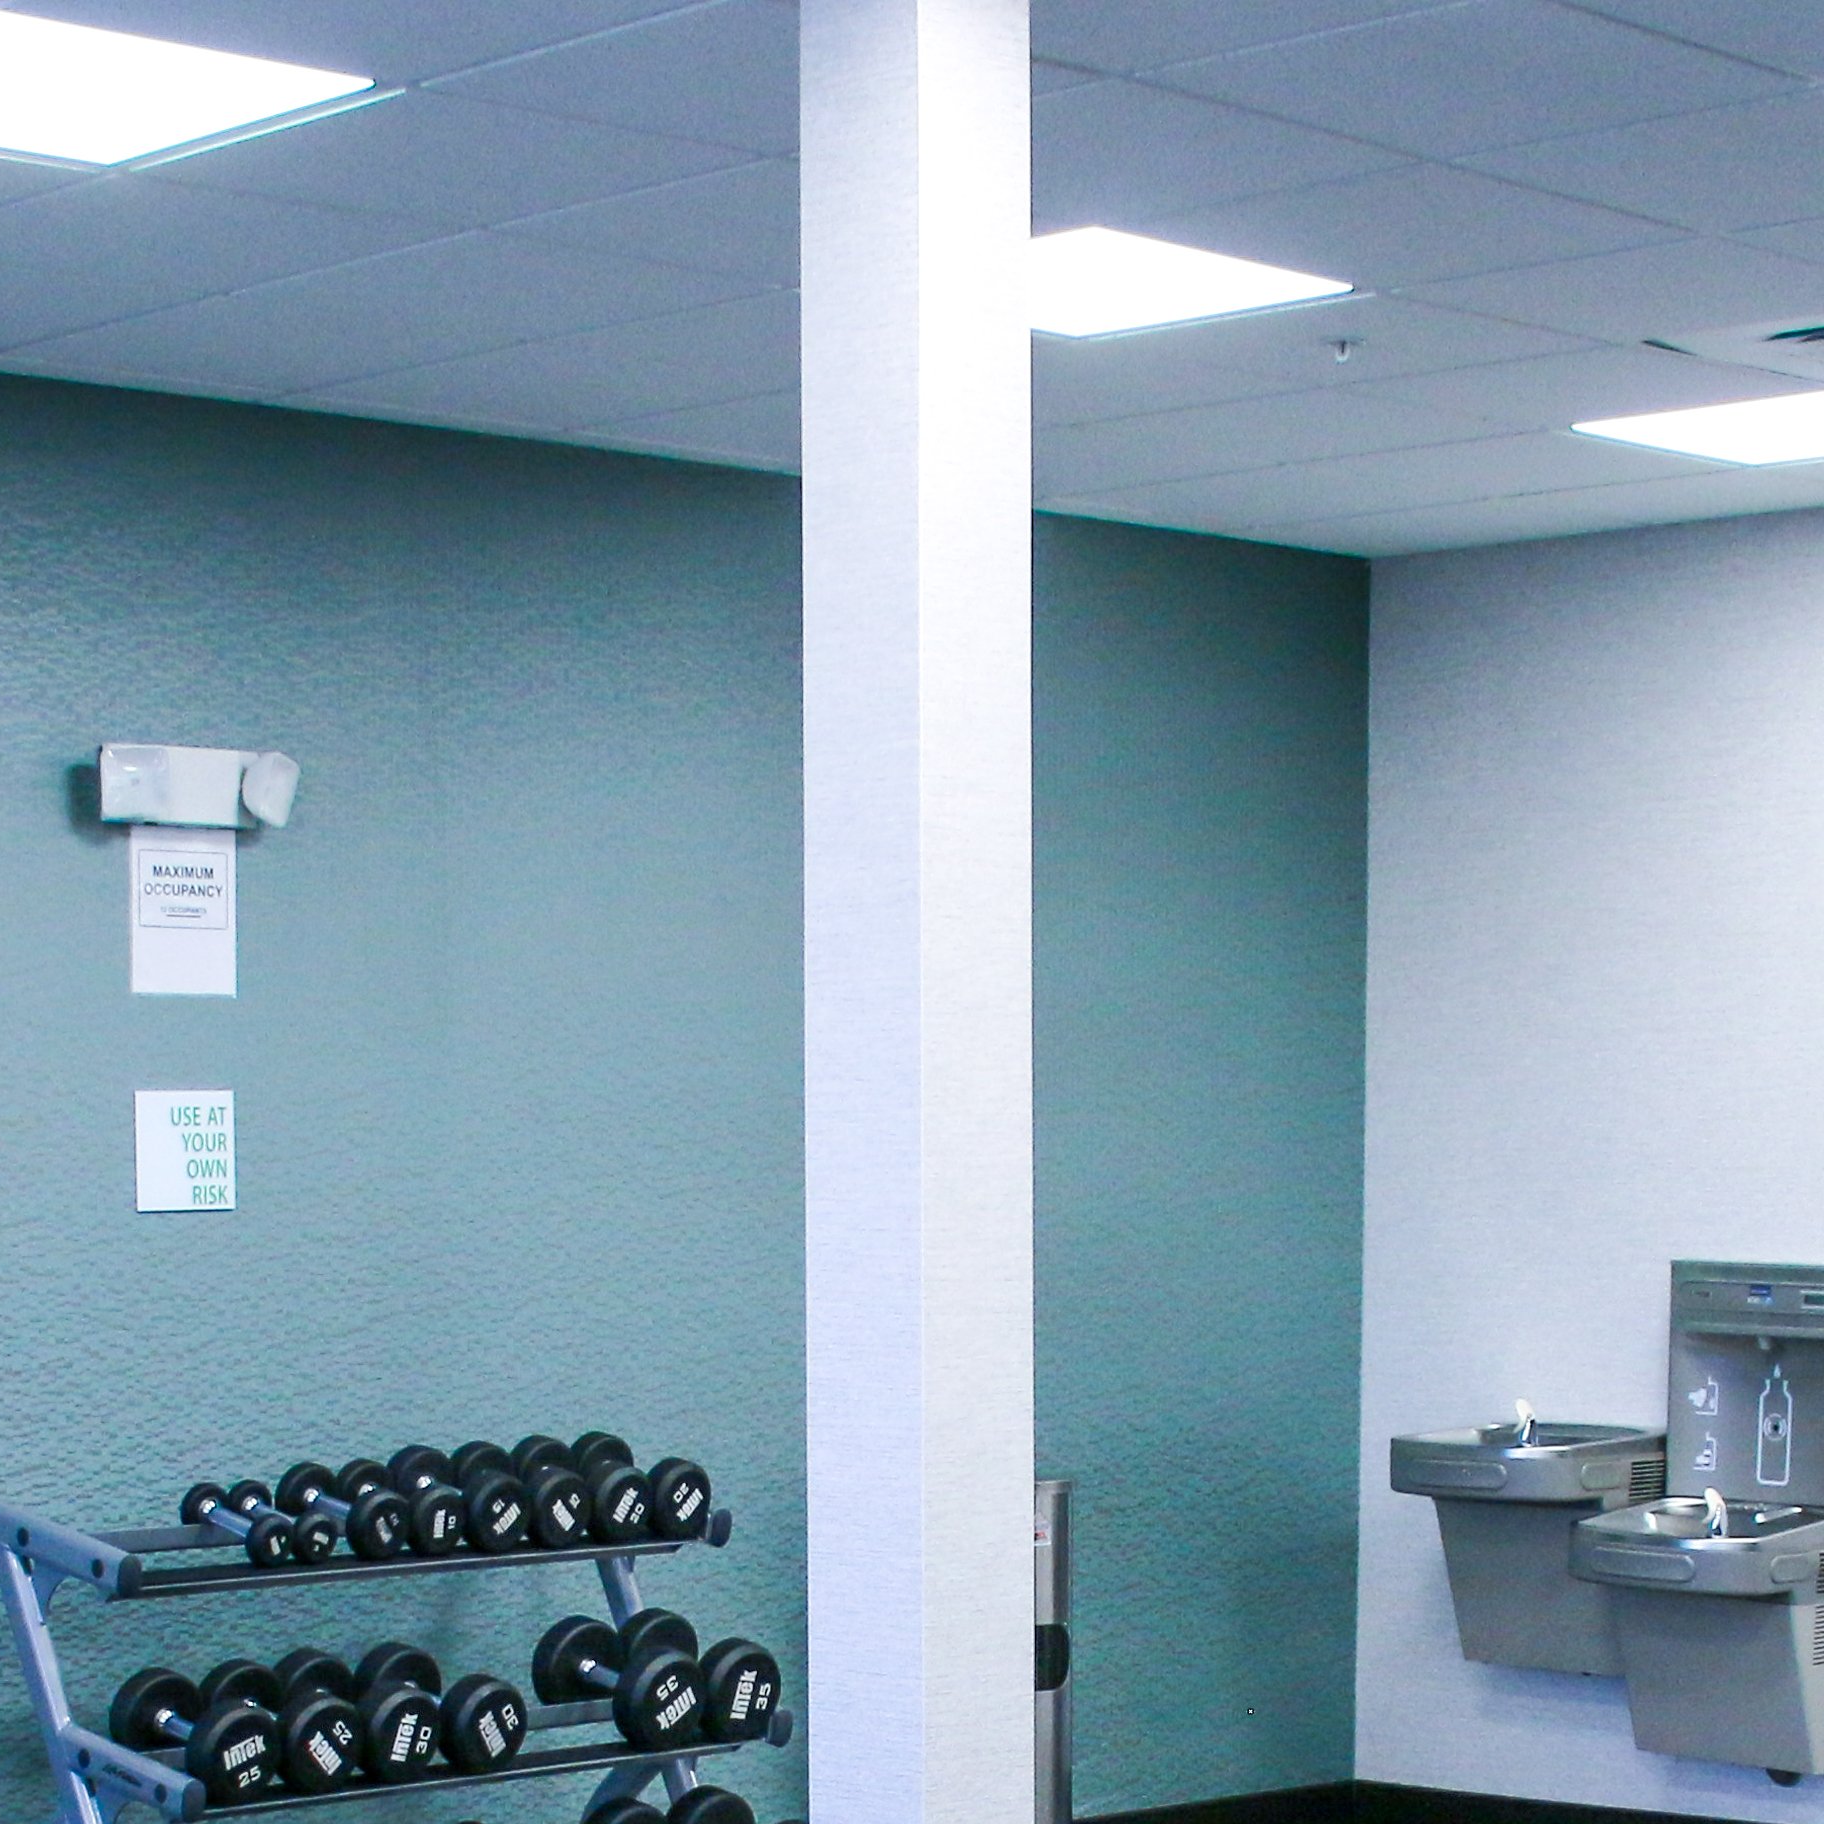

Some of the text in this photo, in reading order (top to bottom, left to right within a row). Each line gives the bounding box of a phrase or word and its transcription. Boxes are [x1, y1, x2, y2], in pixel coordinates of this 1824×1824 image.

[152, 865, 214, 879] MAXIMUM
[144, 883, 223, 898] OCCUPANCY
[170, 1106, 226, 1126] USE AT
[182, 1132, 227, 1152] YOUR
[186, 1159, 227, 1179] OWN
[192, 1185, 228, 1205] RISK
[673, 1483, 689, 1503] 20
[448, 1516, 456, 1529] 10
[630, 1503, 644, 1523] 20
[657, 1676, 678, 1700] 35
[756, 1683, 771, 1709] 35
[502, 1704, 518, 1730] 30
[333, 1721, 352, 1745] 25
[416, 1726, 431, 1753] 30
[239, 1766, 260, 1787] 25
